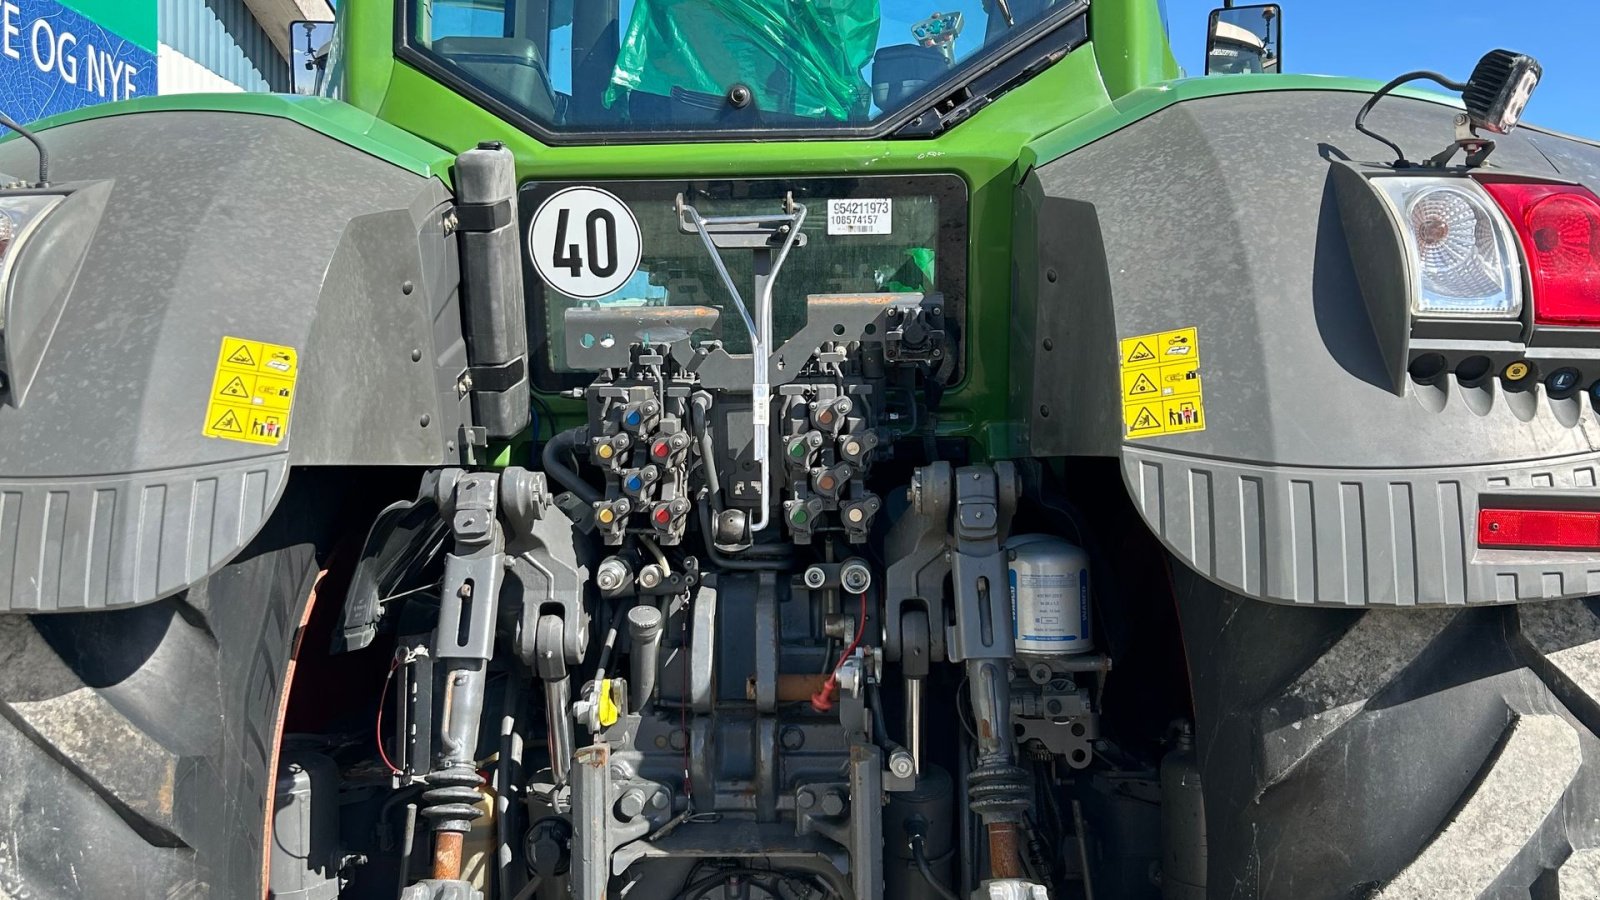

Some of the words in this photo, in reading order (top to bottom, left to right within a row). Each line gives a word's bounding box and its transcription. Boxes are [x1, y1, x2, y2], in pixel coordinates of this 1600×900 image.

[0, 0, 20, 60] E
[32, 18, 77, 84] OG
[87, 44, 137, 102] NYE
[833, 201, 889, 214] 954211973
[553, 208, 618, 278] 40
